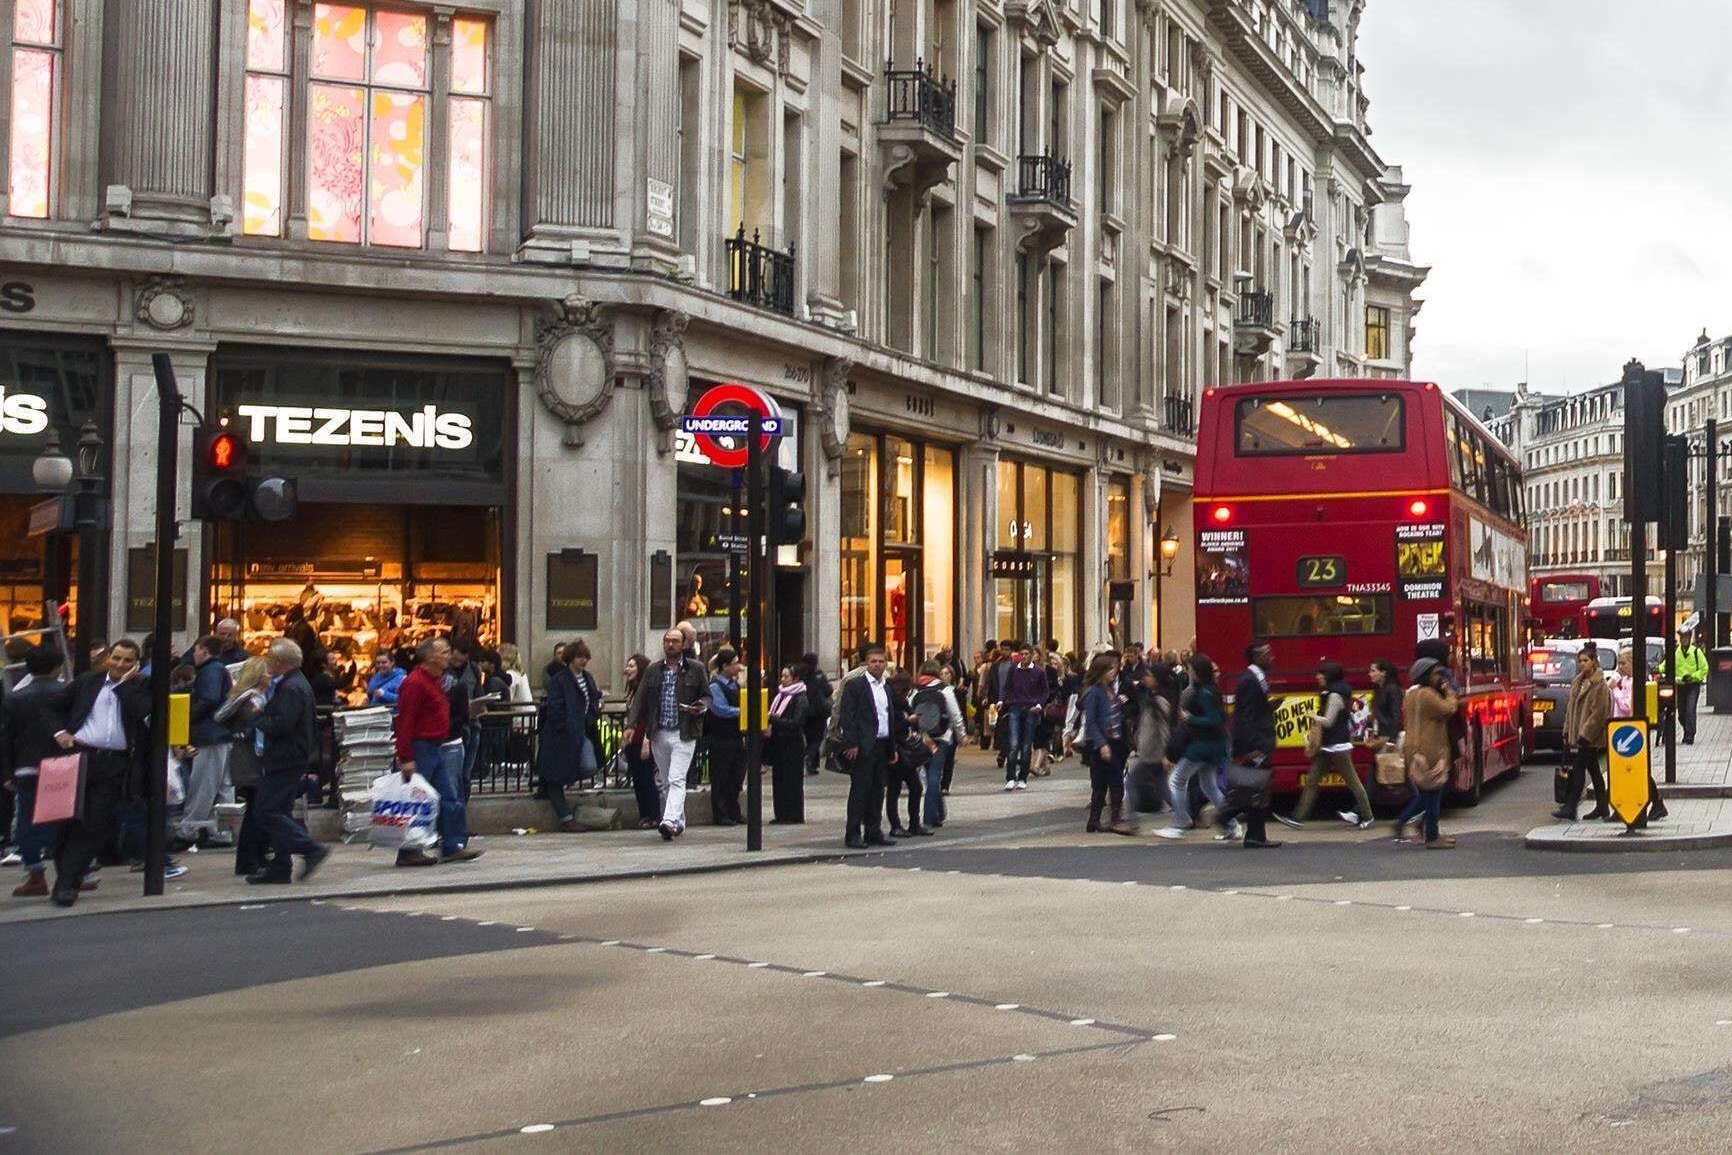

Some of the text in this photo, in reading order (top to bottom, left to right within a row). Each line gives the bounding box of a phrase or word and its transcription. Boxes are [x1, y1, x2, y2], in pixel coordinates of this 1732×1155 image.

[238, 404, 473, 449] TEZENIS
[686, 419, 778, 432] UNDERGROND
[1201, 531, 1243, 541] WINNER!
[1306, 558, 1337, 581] 23
[1404, 583, 1442, 592] DOMINION
[1407, 591, 1439, 600] THEATRE
[1291, 698, 1314, 716] NEW
